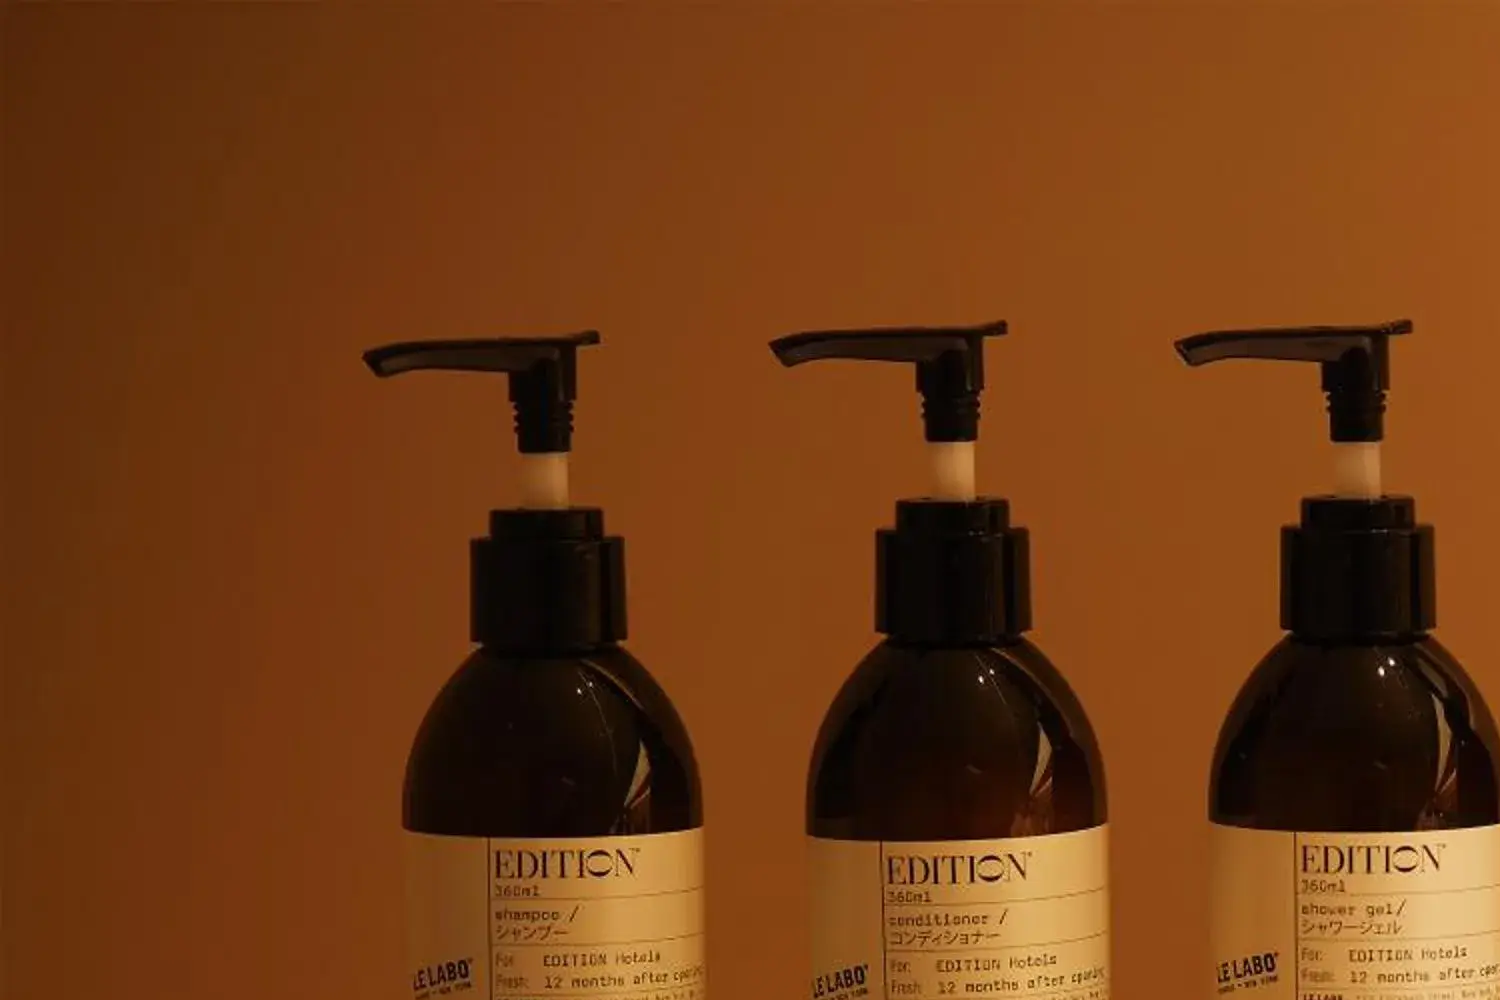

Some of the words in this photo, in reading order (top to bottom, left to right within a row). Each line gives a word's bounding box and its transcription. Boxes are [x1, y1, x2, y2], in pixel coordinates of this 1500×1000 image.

[496, 849, 633, 879] EDITION
[1302, 846, 1440, 874] EDITION
[888, 855, 1028, 884] EDITION
[495, 908, 560, 922] shampoo
[1302, 902, 1356, 916] shower
[889, 911, 988, 926] conditioner
[1302, 921, 1403, 935] シャワージェル
[890, 930, 1002, 946] コンディショナー
[544, 955, 607, 967] EDITION
[615, 952, 660, 965] Hotels
[1349, 947, 1413, 960] EDITION
[1422, 946, 1468, 959] Hotels
[936, 959, 1000, 972] EDITION
[1009, 954, 1057, 970] Hotels
[544, 977, 560, 988] 12
[571, 976, 624, 988] months
[634, 972, 668, 985] after
[1350, 970, 1367, 982] 12
[1377, 970, 1429, 982] months
[1439, 966, 1476, 980] after
[938, 981, 957, 994] 12
[966, 980, 1018, 992] months
[1027, 974, 1064, 990] after
